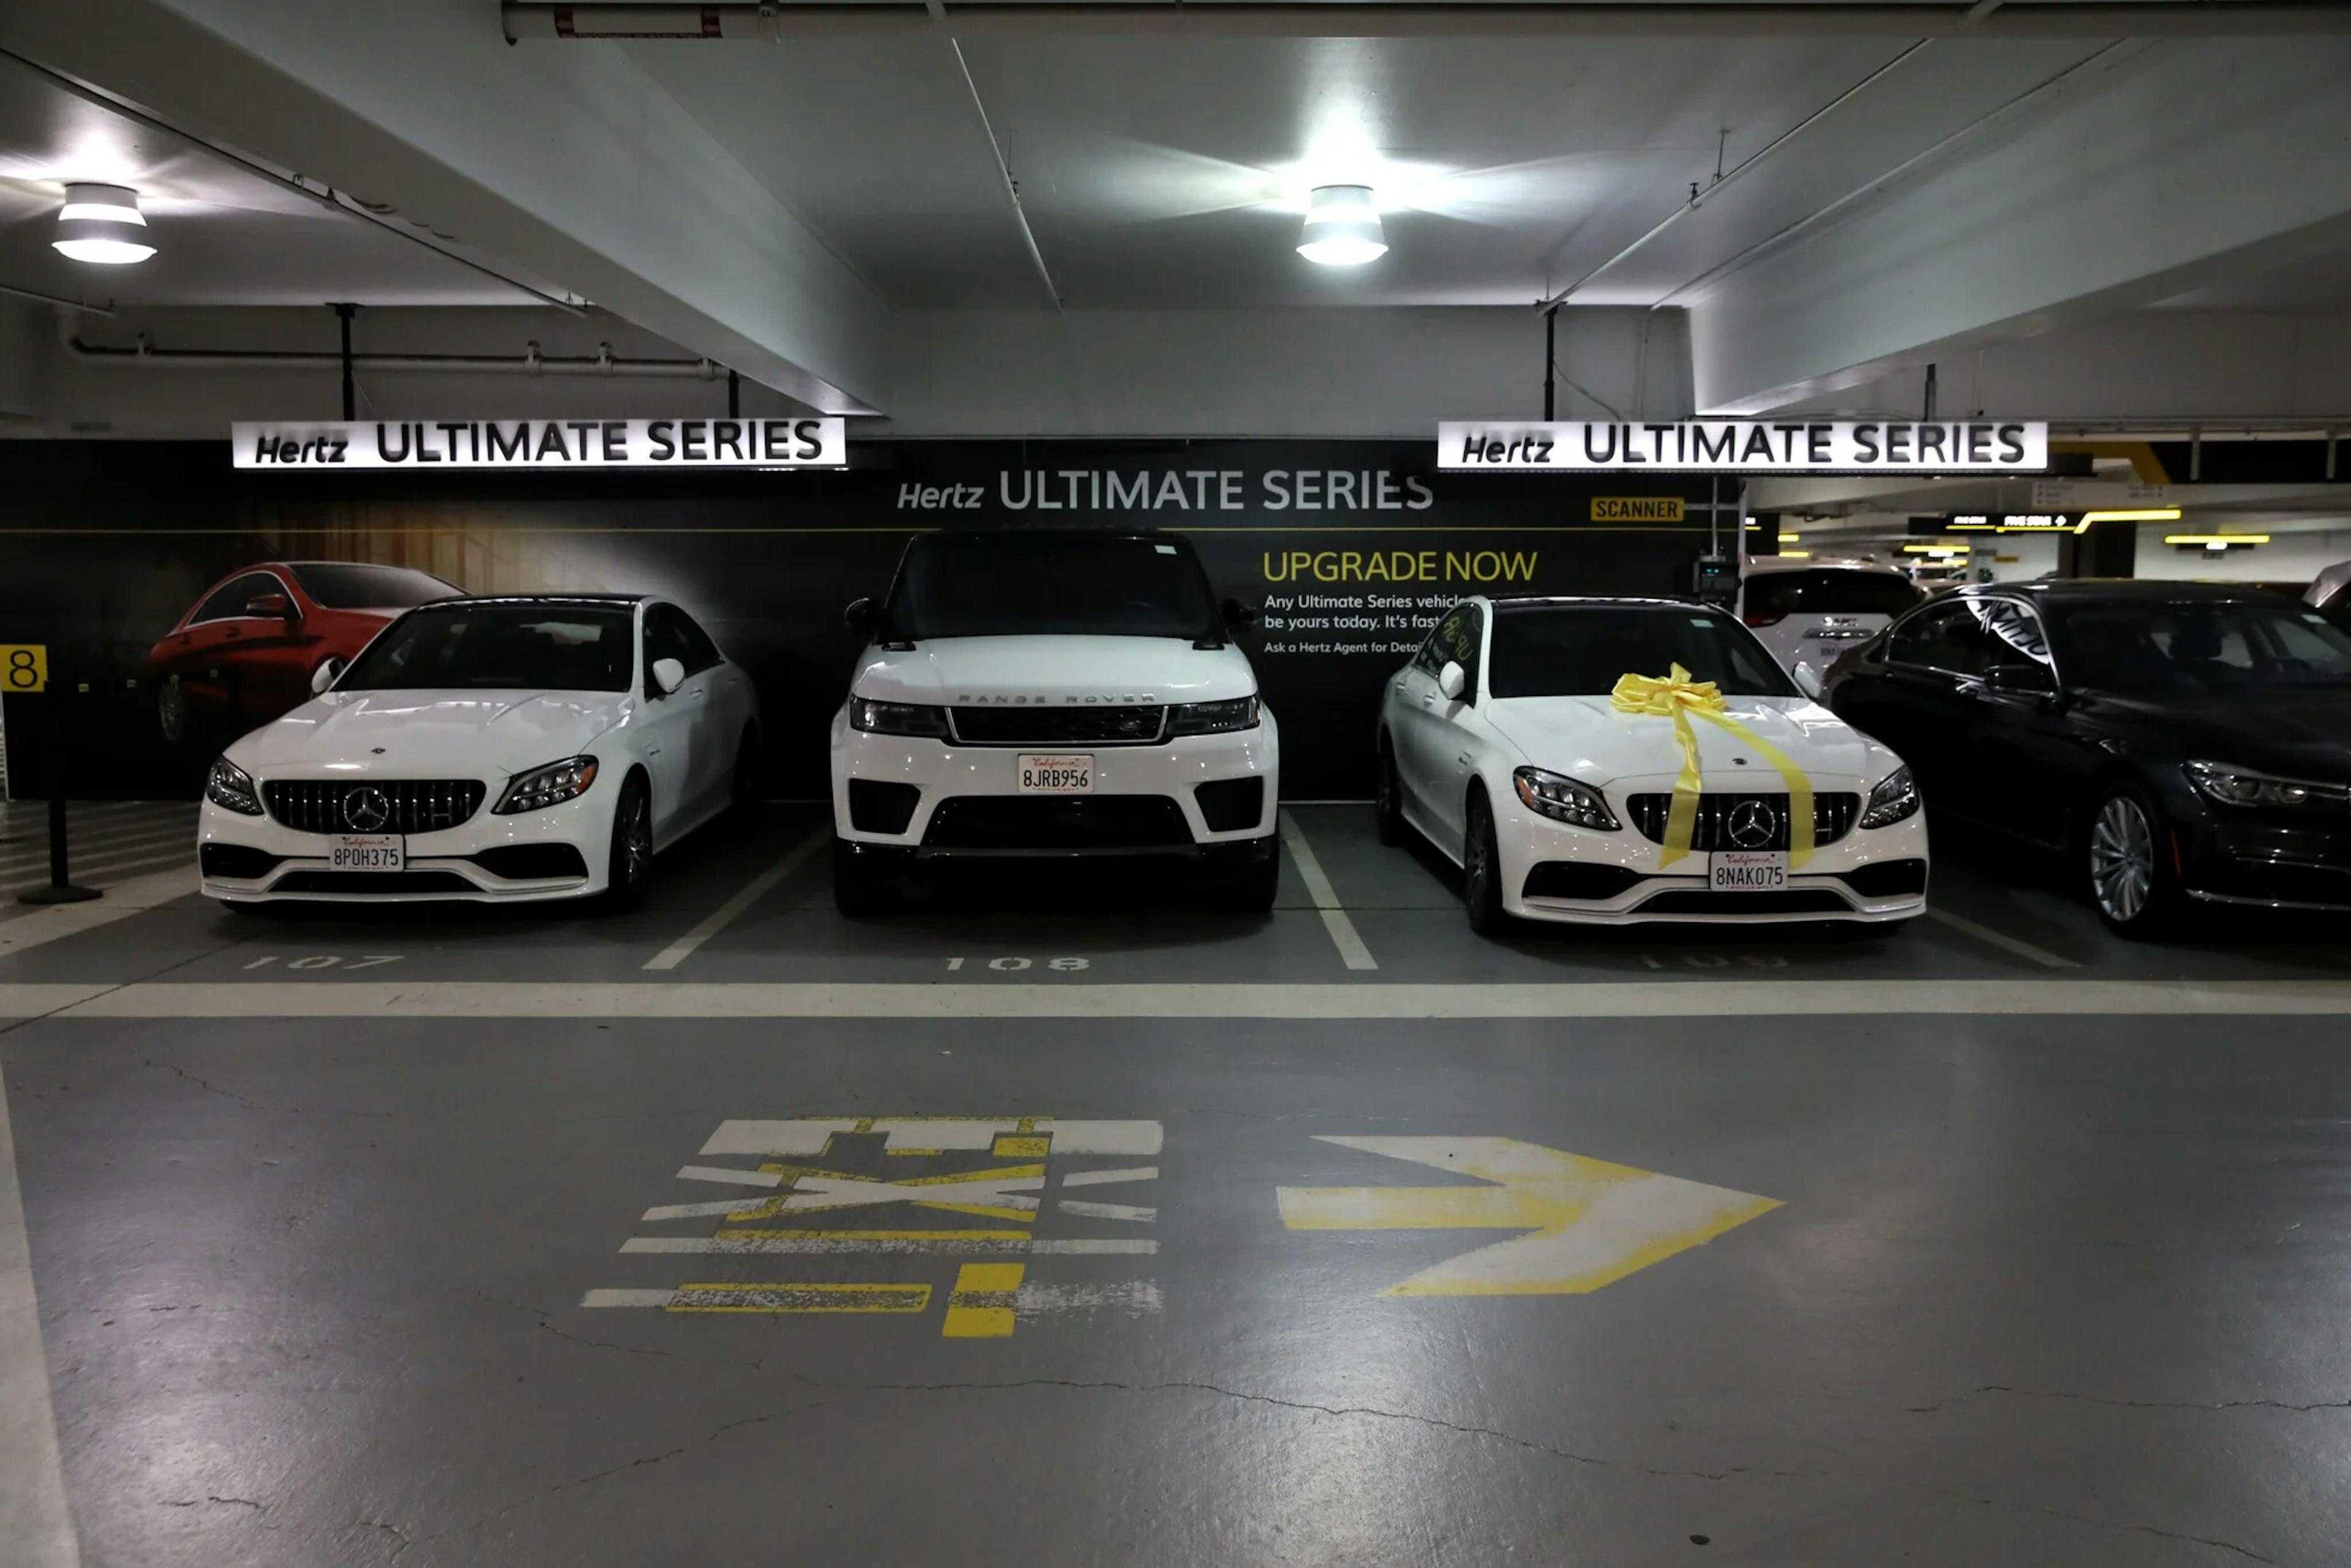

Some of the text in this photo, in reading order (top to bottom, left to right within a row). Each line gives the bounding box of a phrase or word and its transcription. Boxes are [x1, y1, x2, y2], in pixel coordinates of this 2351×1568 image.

[256, 421, 822, 463] Hertz ULTIMATE SERIES
[1462, 424, 2025, 463] Hertz ULTIMATE SERIES
[898, 470, 1433, 511] Hertz ULTIMATE SERIES
[1596, 500, 1678, 518] SCANNER
[1264, 551, 1537, 581] UPGRADE NOW
[1264, 595, 1294, 611] Any
[1299, 595, 1363, 609] Ultimate
[1367, 595, 1413, 609] Series
[1265, 615, 1284, 629] be
[1288, 618, 1329, 632] yours
[1333, 615, 1381, 632] today.
[1385, 614, 1408, 628] It's
[1264, 642, 1286, 653] Ask
[1288, 644, 1297, 653] a
[1299, 642, 1330, 653] Hertz
[1333, 642, 1368, 656] Agent
[1371, 641, 1388, 653] for
[9, 650, 38, 688] 8
[958, 692, 1155, 704] RANGE ROVER
[1024, 770, 1088, 787] 8JRB956
[243, 955, 405, 970] 107
[947, 957, 1090, 971] 108
